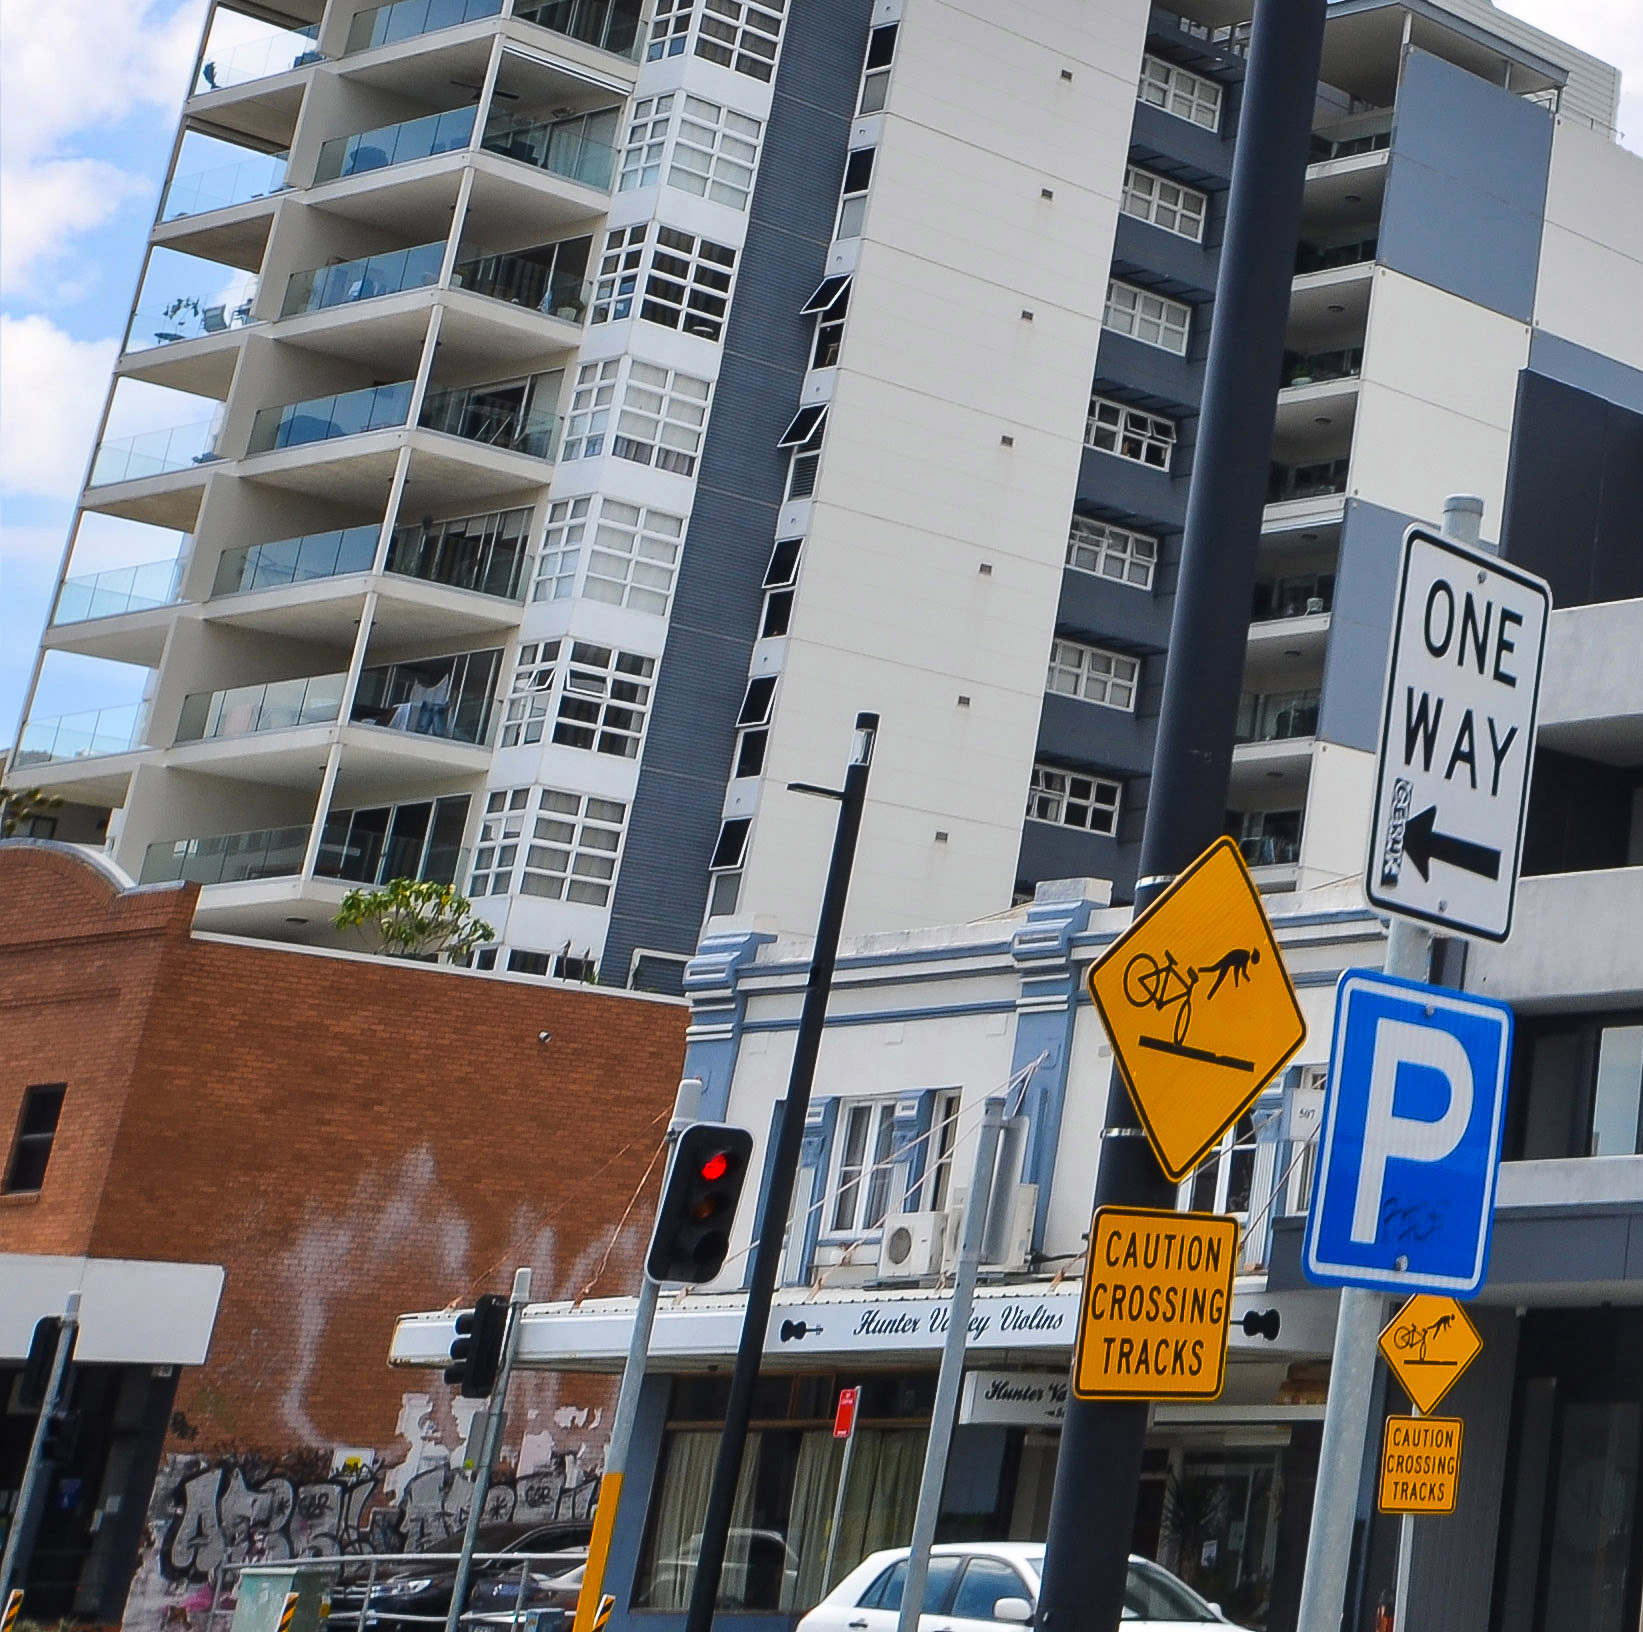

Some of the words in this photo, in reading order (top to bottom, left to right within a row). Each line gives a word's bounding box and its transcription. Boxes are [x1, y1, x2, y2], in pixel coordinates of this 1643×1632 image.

[1423, 577, 1523, 688] ONE
[1404, 685, 1518, 797] WAY
[1299, 1108, 1316, 1120] 507
[1350, 1017, 1475, 1246] P
[1105, 1230, 1222, 1273] CAUTION
[852, 1308, 922, 1335] Hunter
[929, 1306, 991, 1341] Vaey
[1000, 1304, 1065, 1332] Violins
[1091, 1282, 1225, 1325] CROSSING
[1103, 1336, 1205, 1377] TRACKS
[984, 1380, 1045, 1402] Hunter
[1392, 1427, 1455, 1450] CAUTION
[1386, 1454, 1455, 1476] CROSSING
[1392, 1481, 1446, 1503] TRACKS
